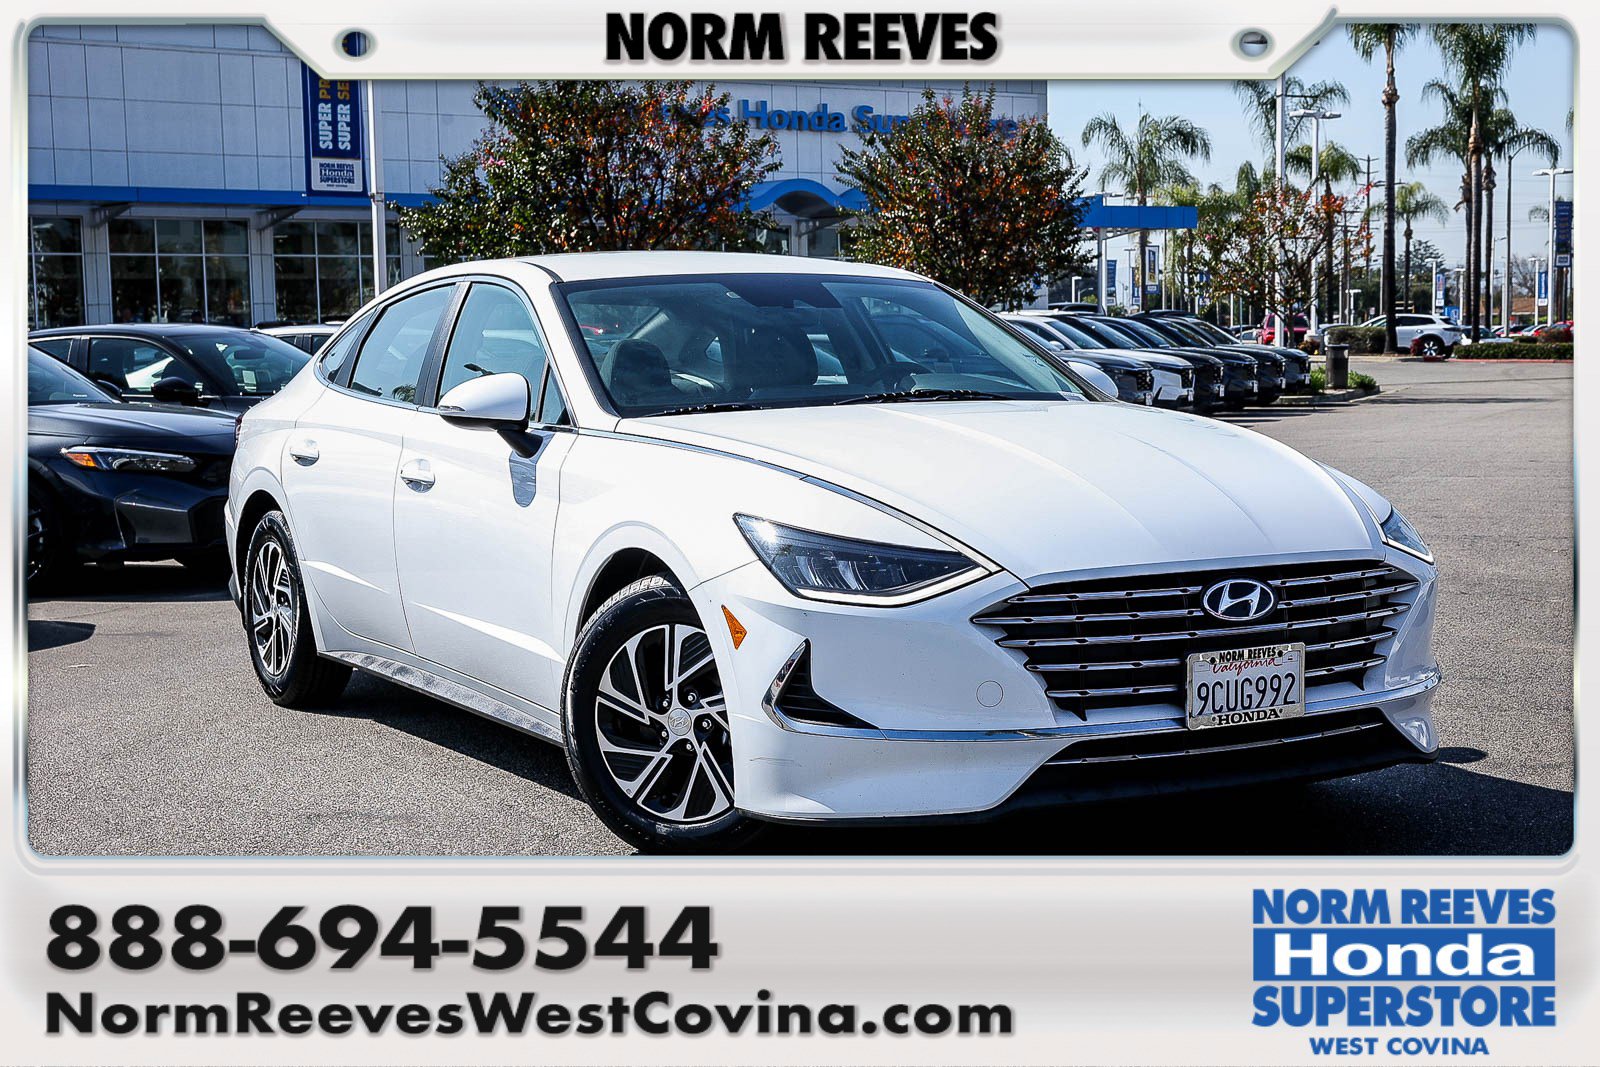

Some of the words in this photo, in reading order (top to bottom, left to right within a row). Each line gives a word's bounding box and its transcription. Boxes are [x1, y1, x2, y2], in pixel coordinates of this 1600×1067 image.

[337, 80, 350, 100] SE
[738, 99, 848, 132] Honda
[318, 103, 333, 150] SUPER
[337, 104, 351, 151] SUPER
[321, 169, 353, 177] Honda
[1220, 650, 1245, 662] NORM
[1248, 647, 1276, 660] REEVES
[1212, 657, 1282, 676] California
[1196, 673, 1296, 716] 9CUG992
[1217, 708, 1280, 725] HONDA
